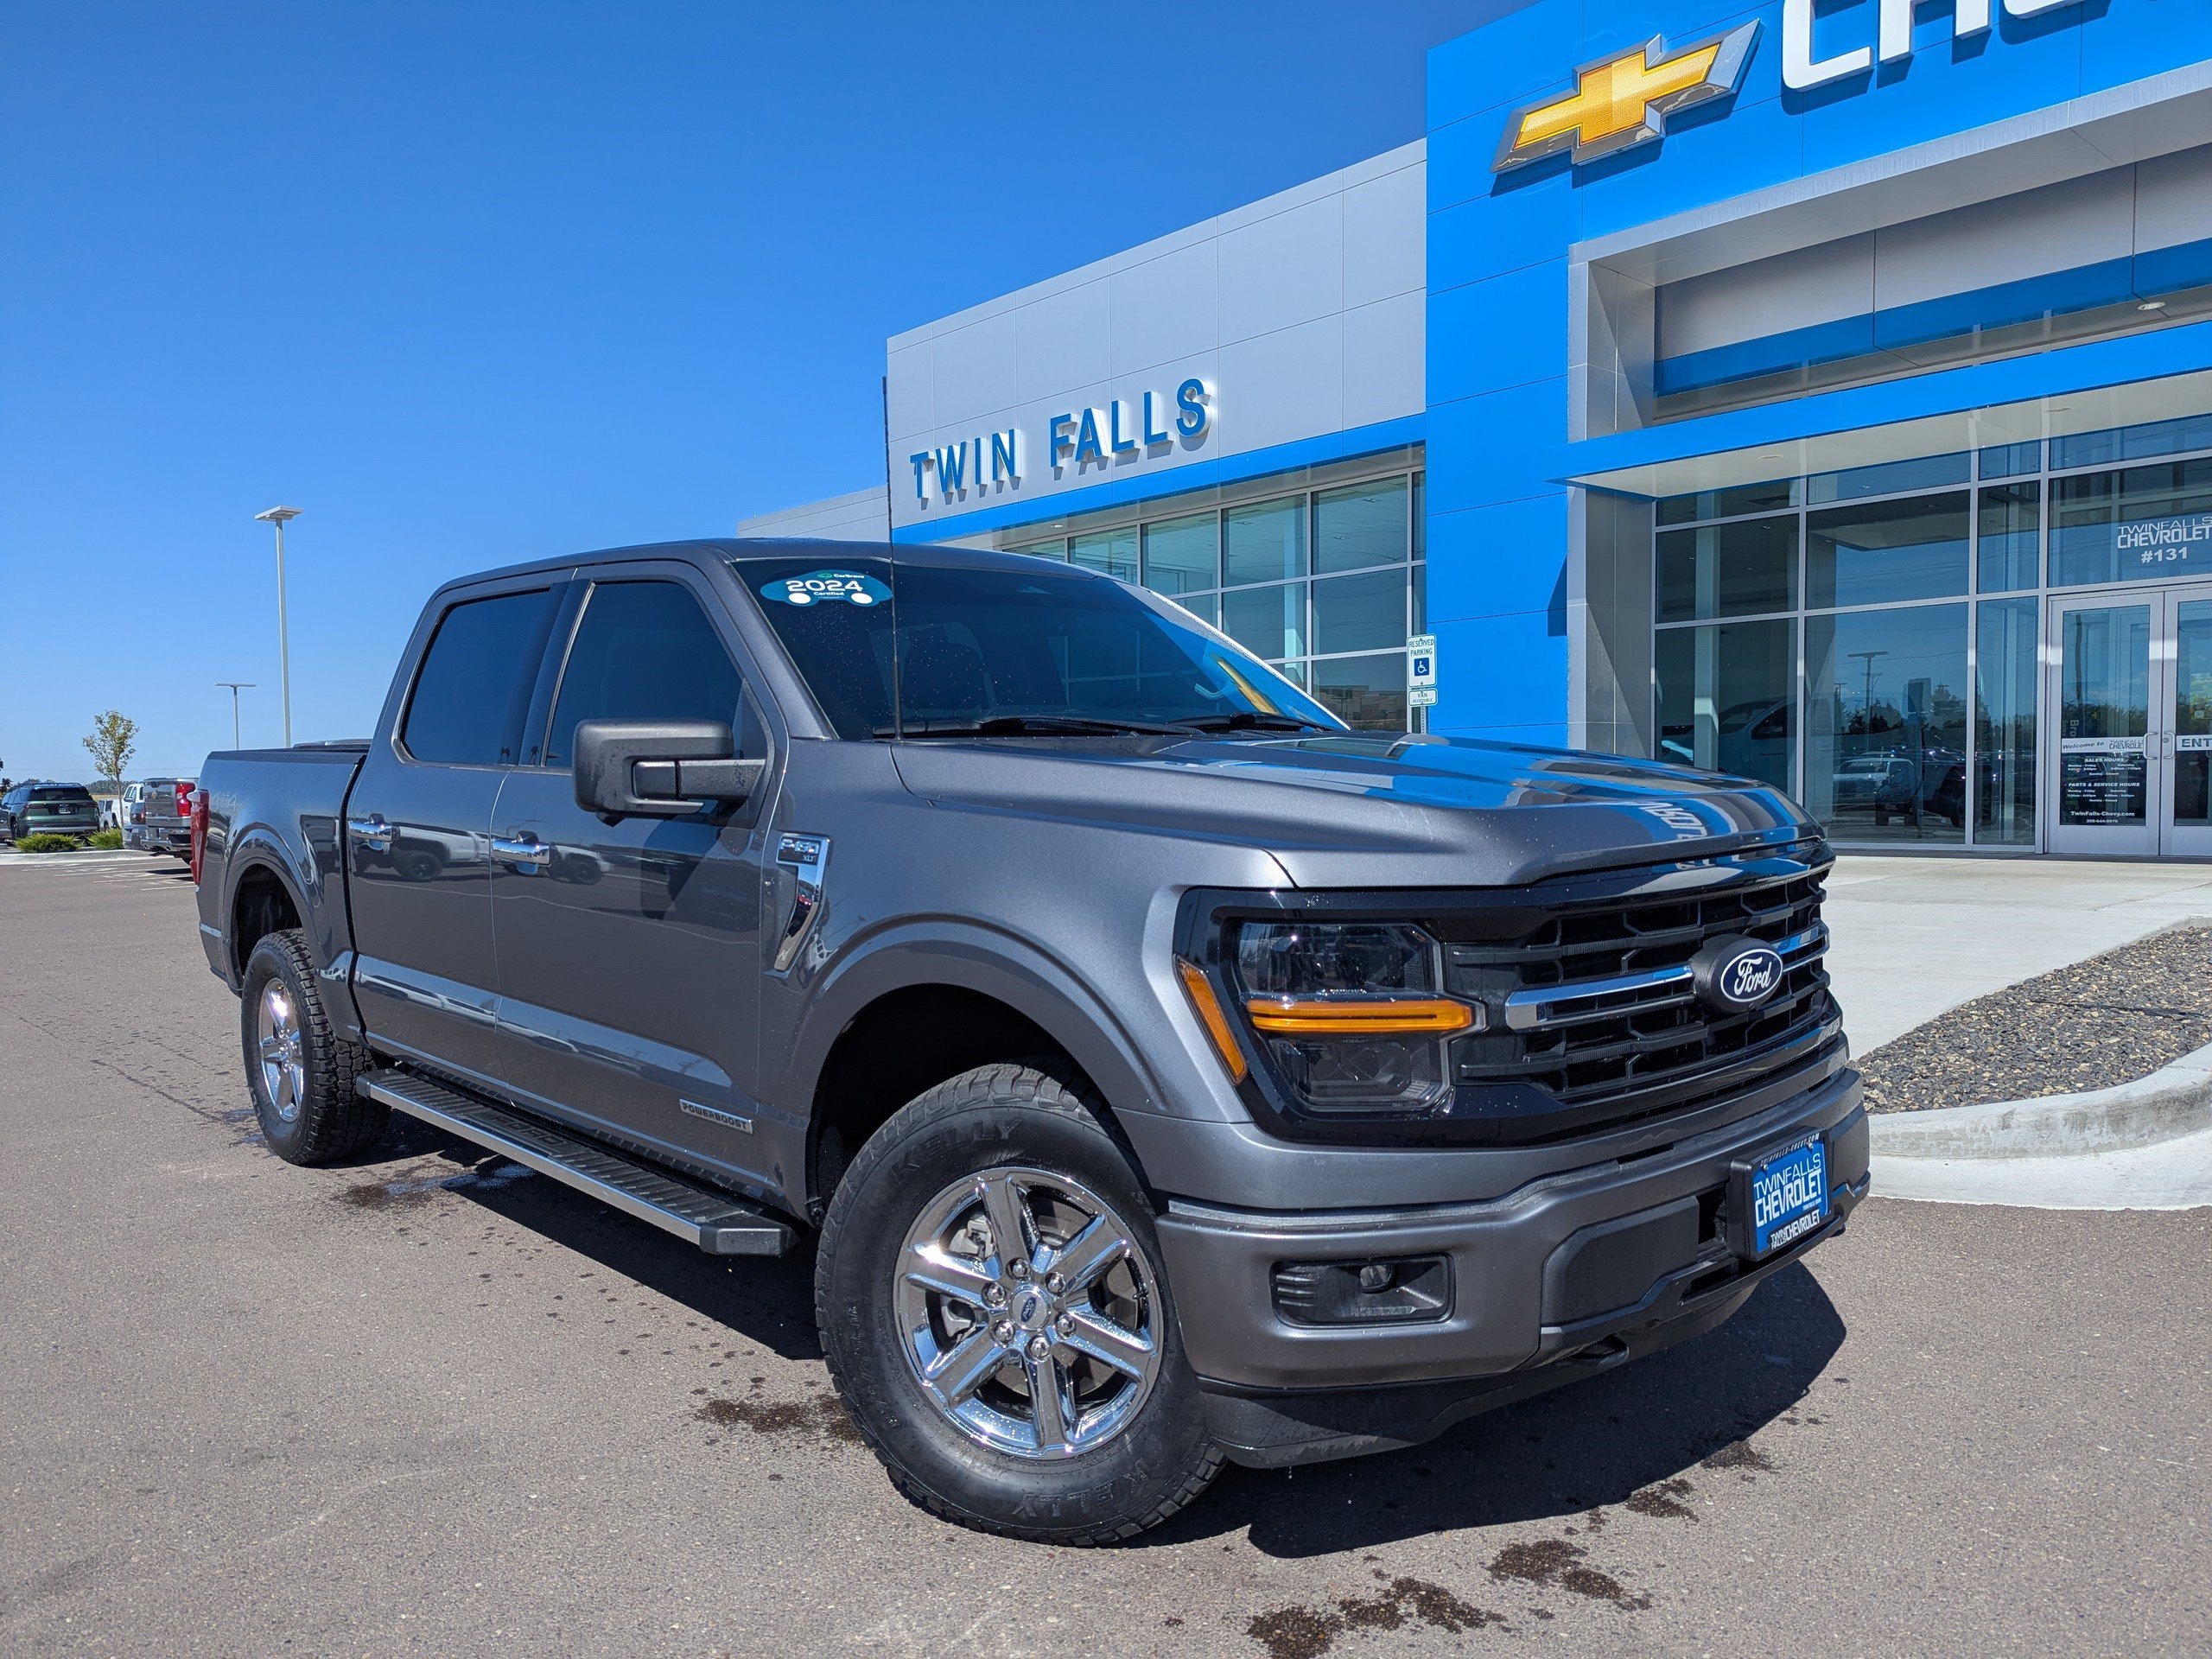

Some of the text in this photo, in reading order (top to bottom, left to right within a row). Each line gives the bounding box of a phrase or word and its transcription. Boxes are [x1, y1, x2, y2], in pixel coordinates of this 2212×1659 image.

[910, 378, 1211, 500] TWIN FALLS
[2117, 525, 2212, 549] CHEVROLET
[2118, 516, 2212, 535] TWINFALLS
[2141, 547, 2188, 563] #131
[785, 580, 863, 592] 2024
[1408, 639, 1434, 647] RESERVED
[1410, 648, 1433, 657] PARKING
[2182, 738, 2212, 747] ENT
[1733, 956, 1772, 995] Ford
[682, 1102, 747, 1129] POWERBOOST
[890, 1118, 1023, 1185] KELLY
[1754, 1153, 1821, 1198] TWINFALLS
[1755, 1168, 1822, 1228] CHEVROLET
[1770, 1227, 1786, 1243] TWIN
[1785, 1209, 1820, 1241] CHEVROLET
